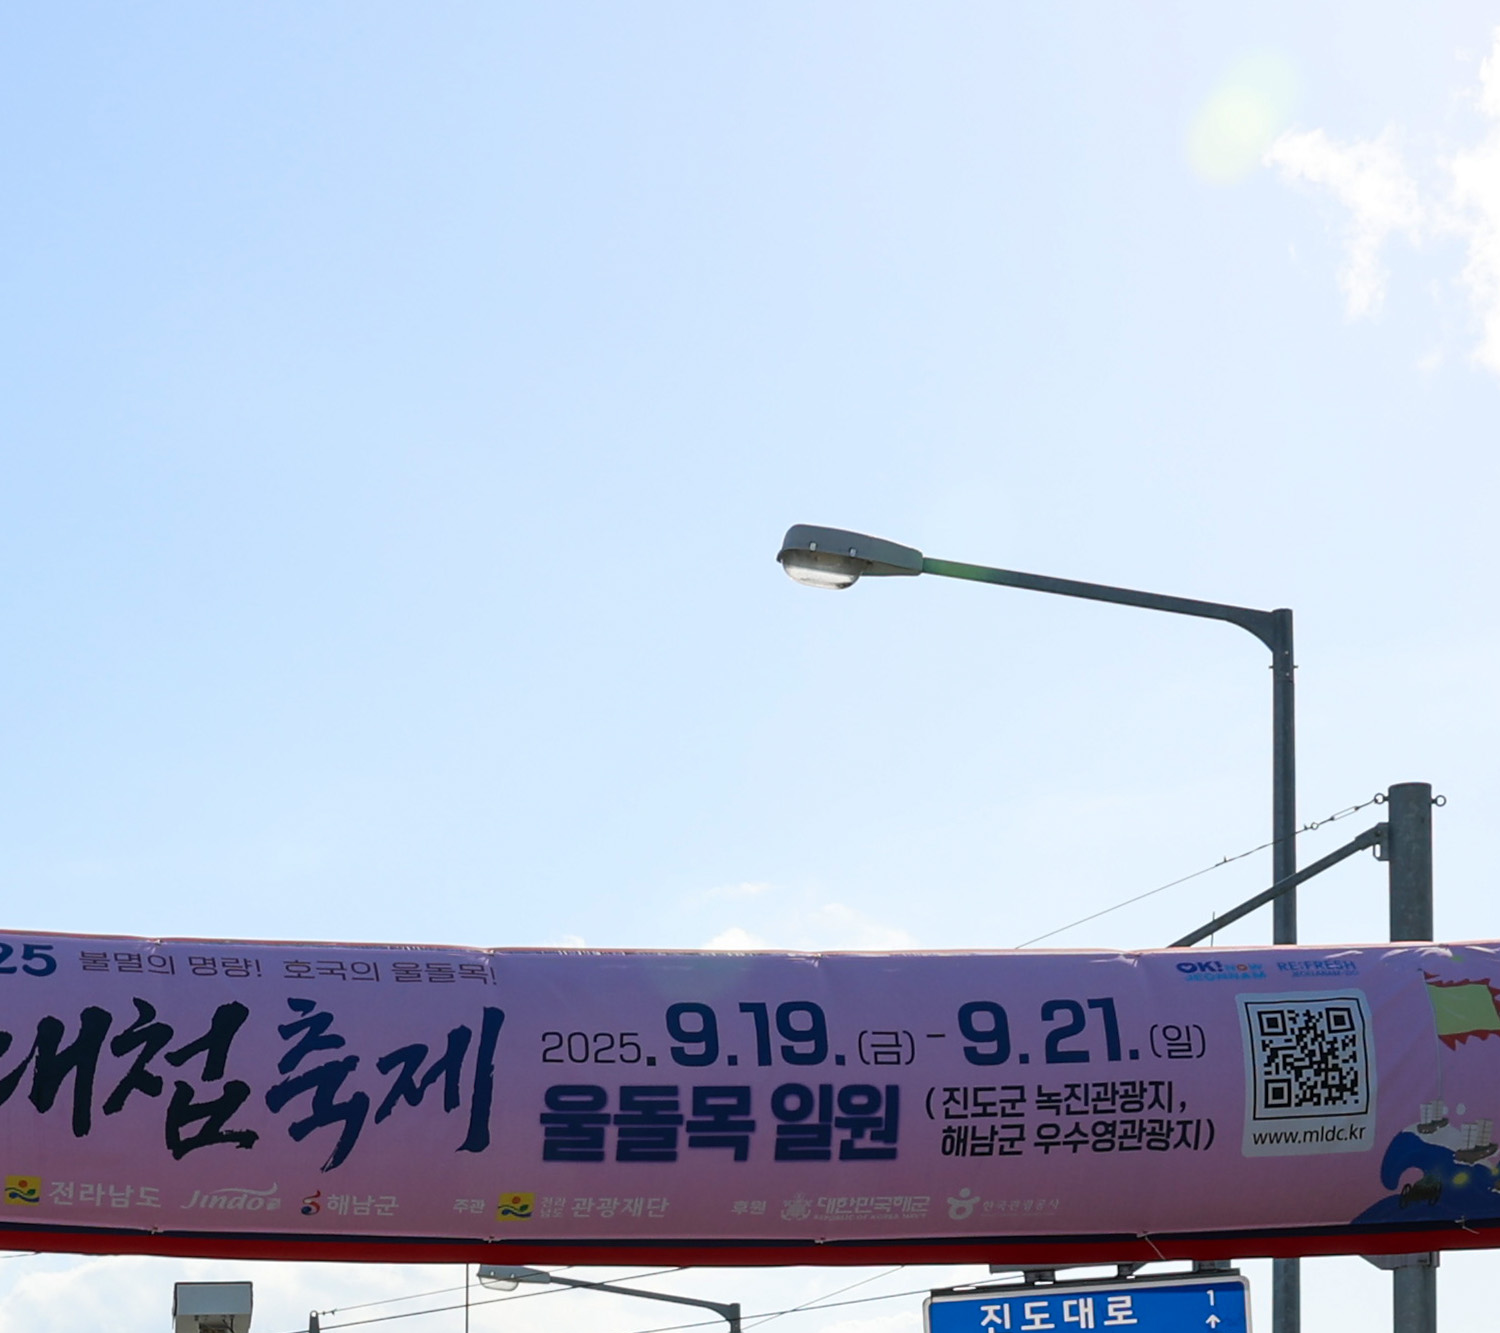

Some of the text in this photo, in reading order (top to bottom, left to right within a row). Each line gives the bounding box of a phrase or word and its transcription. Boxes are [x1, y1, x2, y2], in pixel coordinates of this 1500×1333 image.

[79, 951, 176, 976] 불멸의
[189, 956, 262, 980] 명량!
[283, 959, 380, 983] 호국의
[391, 961, 497, 986] 울돌목!
[1035, 1080, 1187, 1116] 녹진관광지,
[540, 1082, 900, 1163] 울돌목 일원
[941, 1118, 1216, 1157] 해남군 우수영관광지)
[1253, 1125, 1366, 1145] www.mldc.kr
[49, 1181, 162, 1209] 전라남도
[327, 1193, 400, 1216] 해남군
[452, 1197, 486, 1214] 주관
[817, 1196, 931, 1214] 대한민국해군
[571, 1196, 671, 1218] 관광재단
[1205, 1289, 1215, 1307] 1
